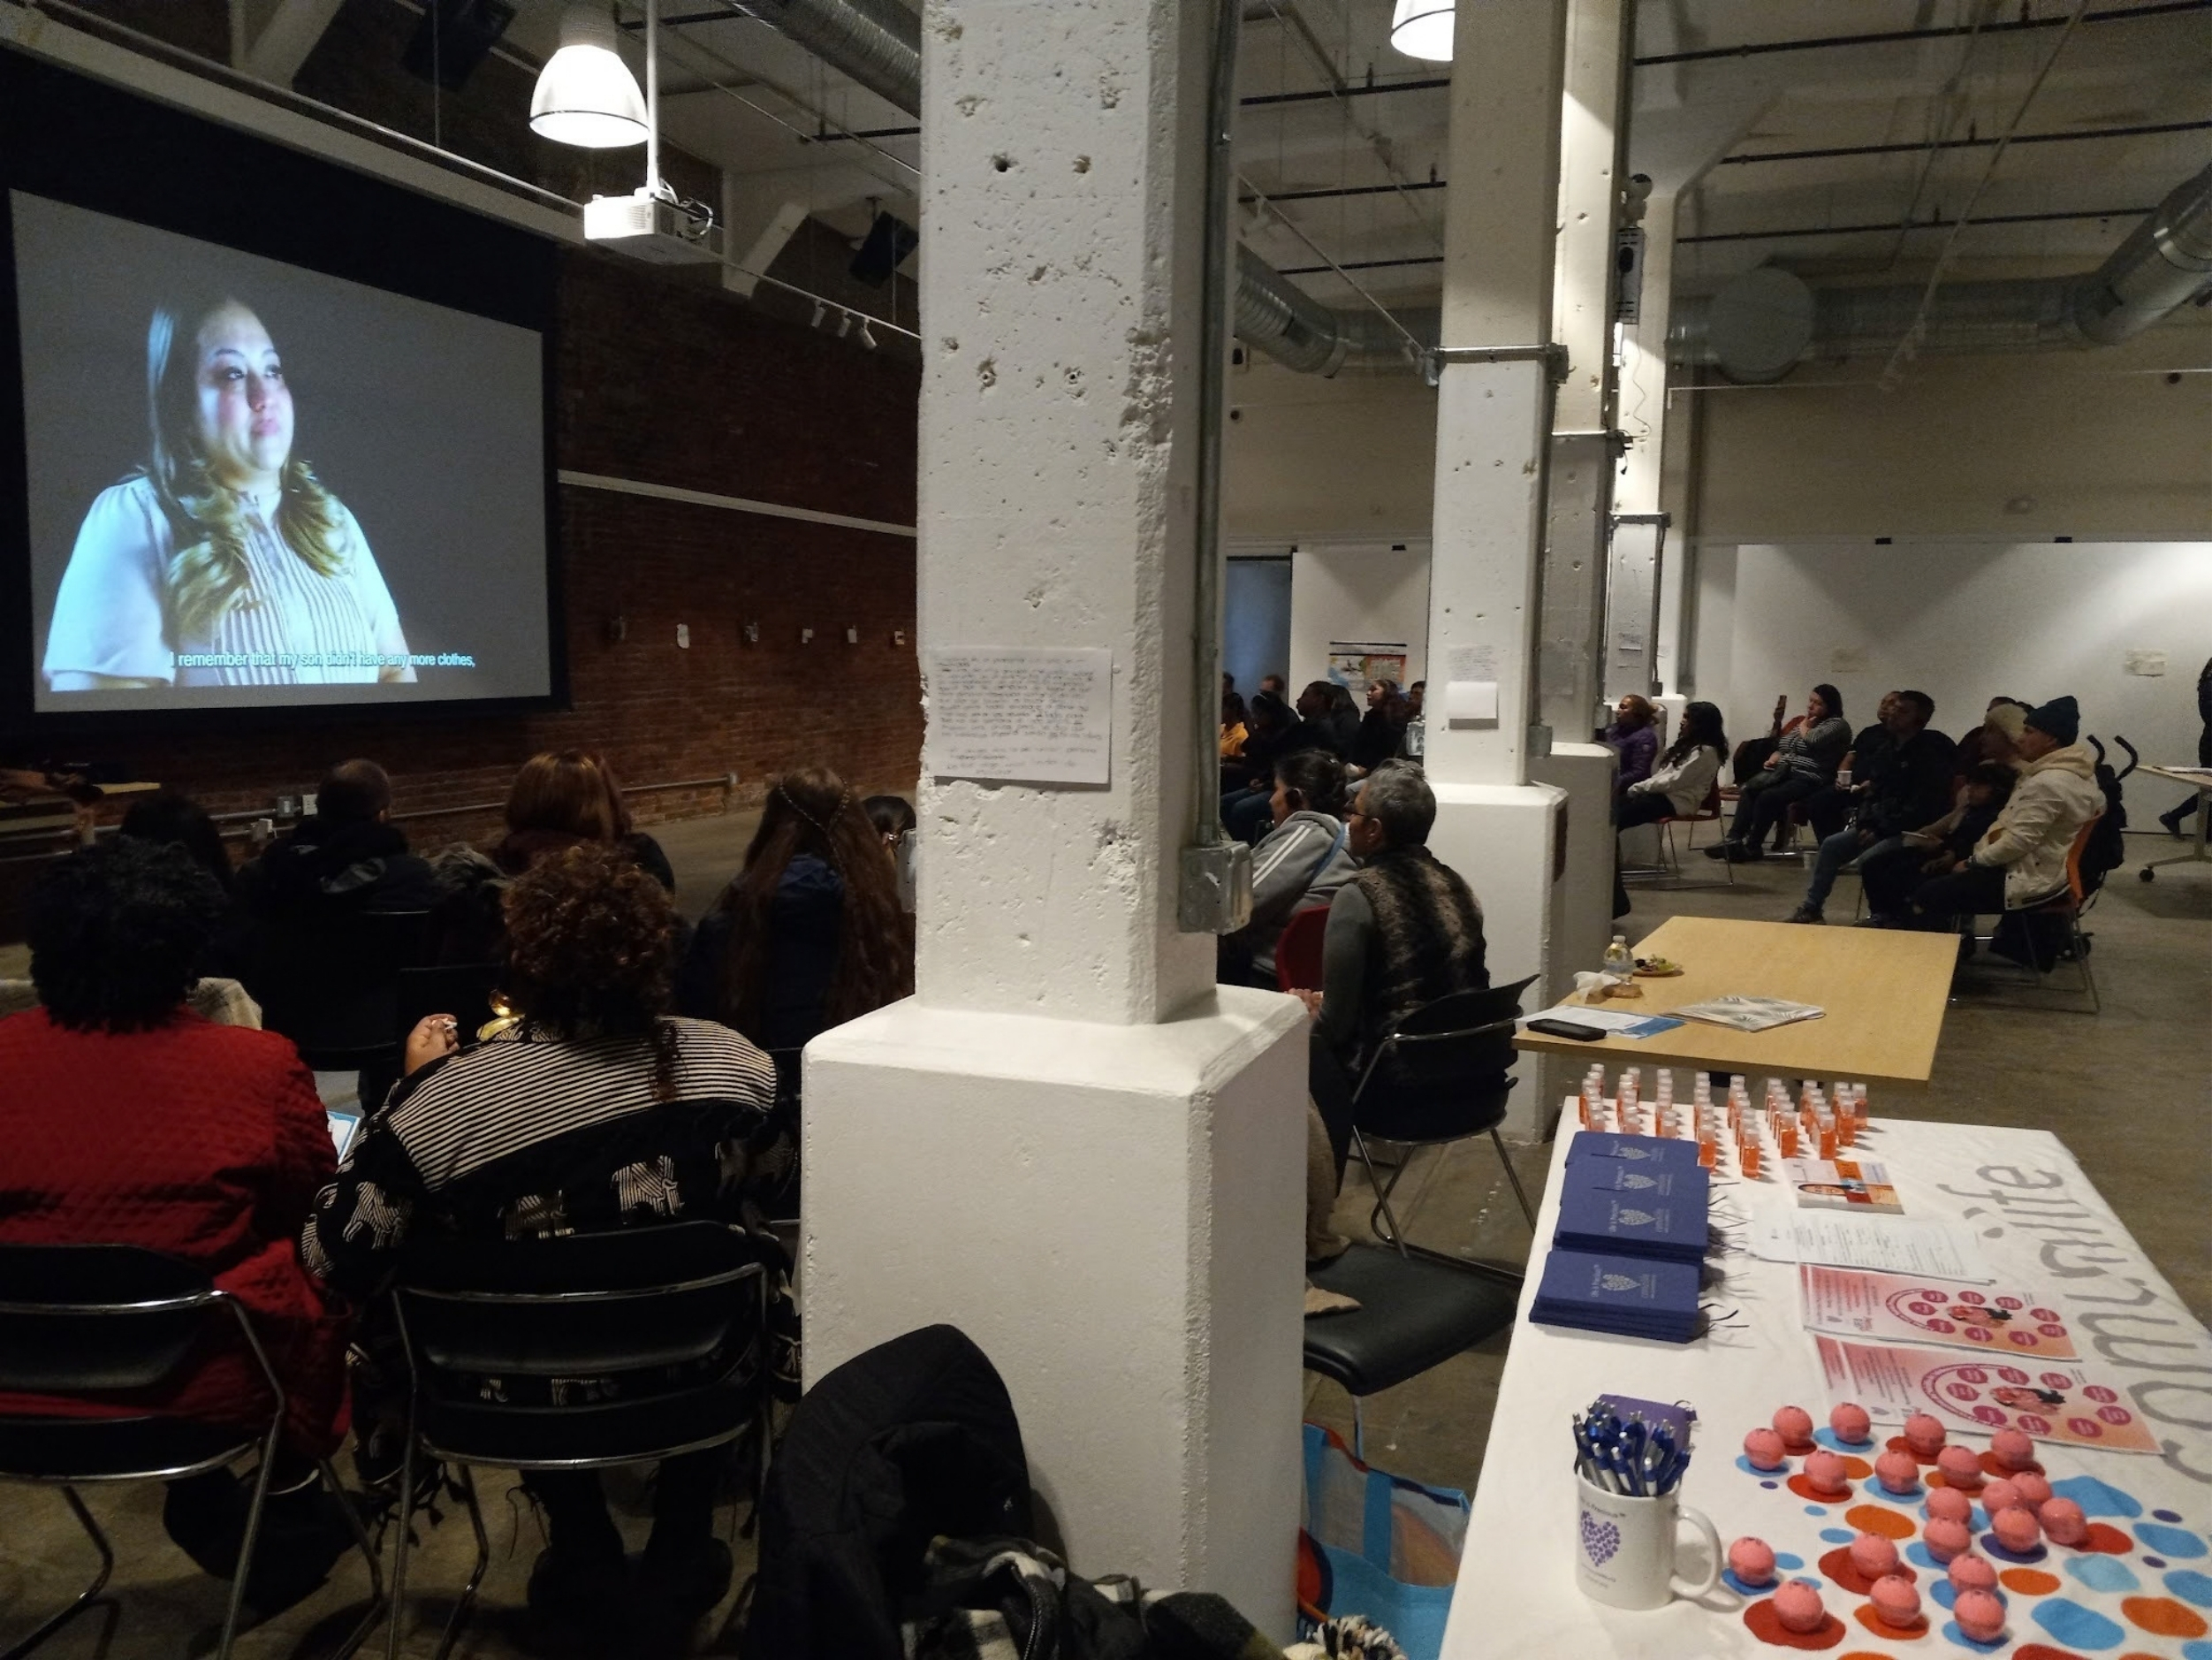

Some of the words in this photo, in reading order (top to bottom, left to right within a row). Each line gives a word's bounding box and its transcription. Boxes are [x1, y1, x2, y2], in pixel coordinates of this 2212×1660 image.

[179, 651, 248, 666] remember
[252, 651, 276, 666] that
[279, 654, 298, 670] my
[301, 654, 322, 666] son
[359, 651, 384, 666] have
[387, 655, 407, 669] any
[408, 655, 436, 666] more
[437, 652, 475, 667] clothes,
